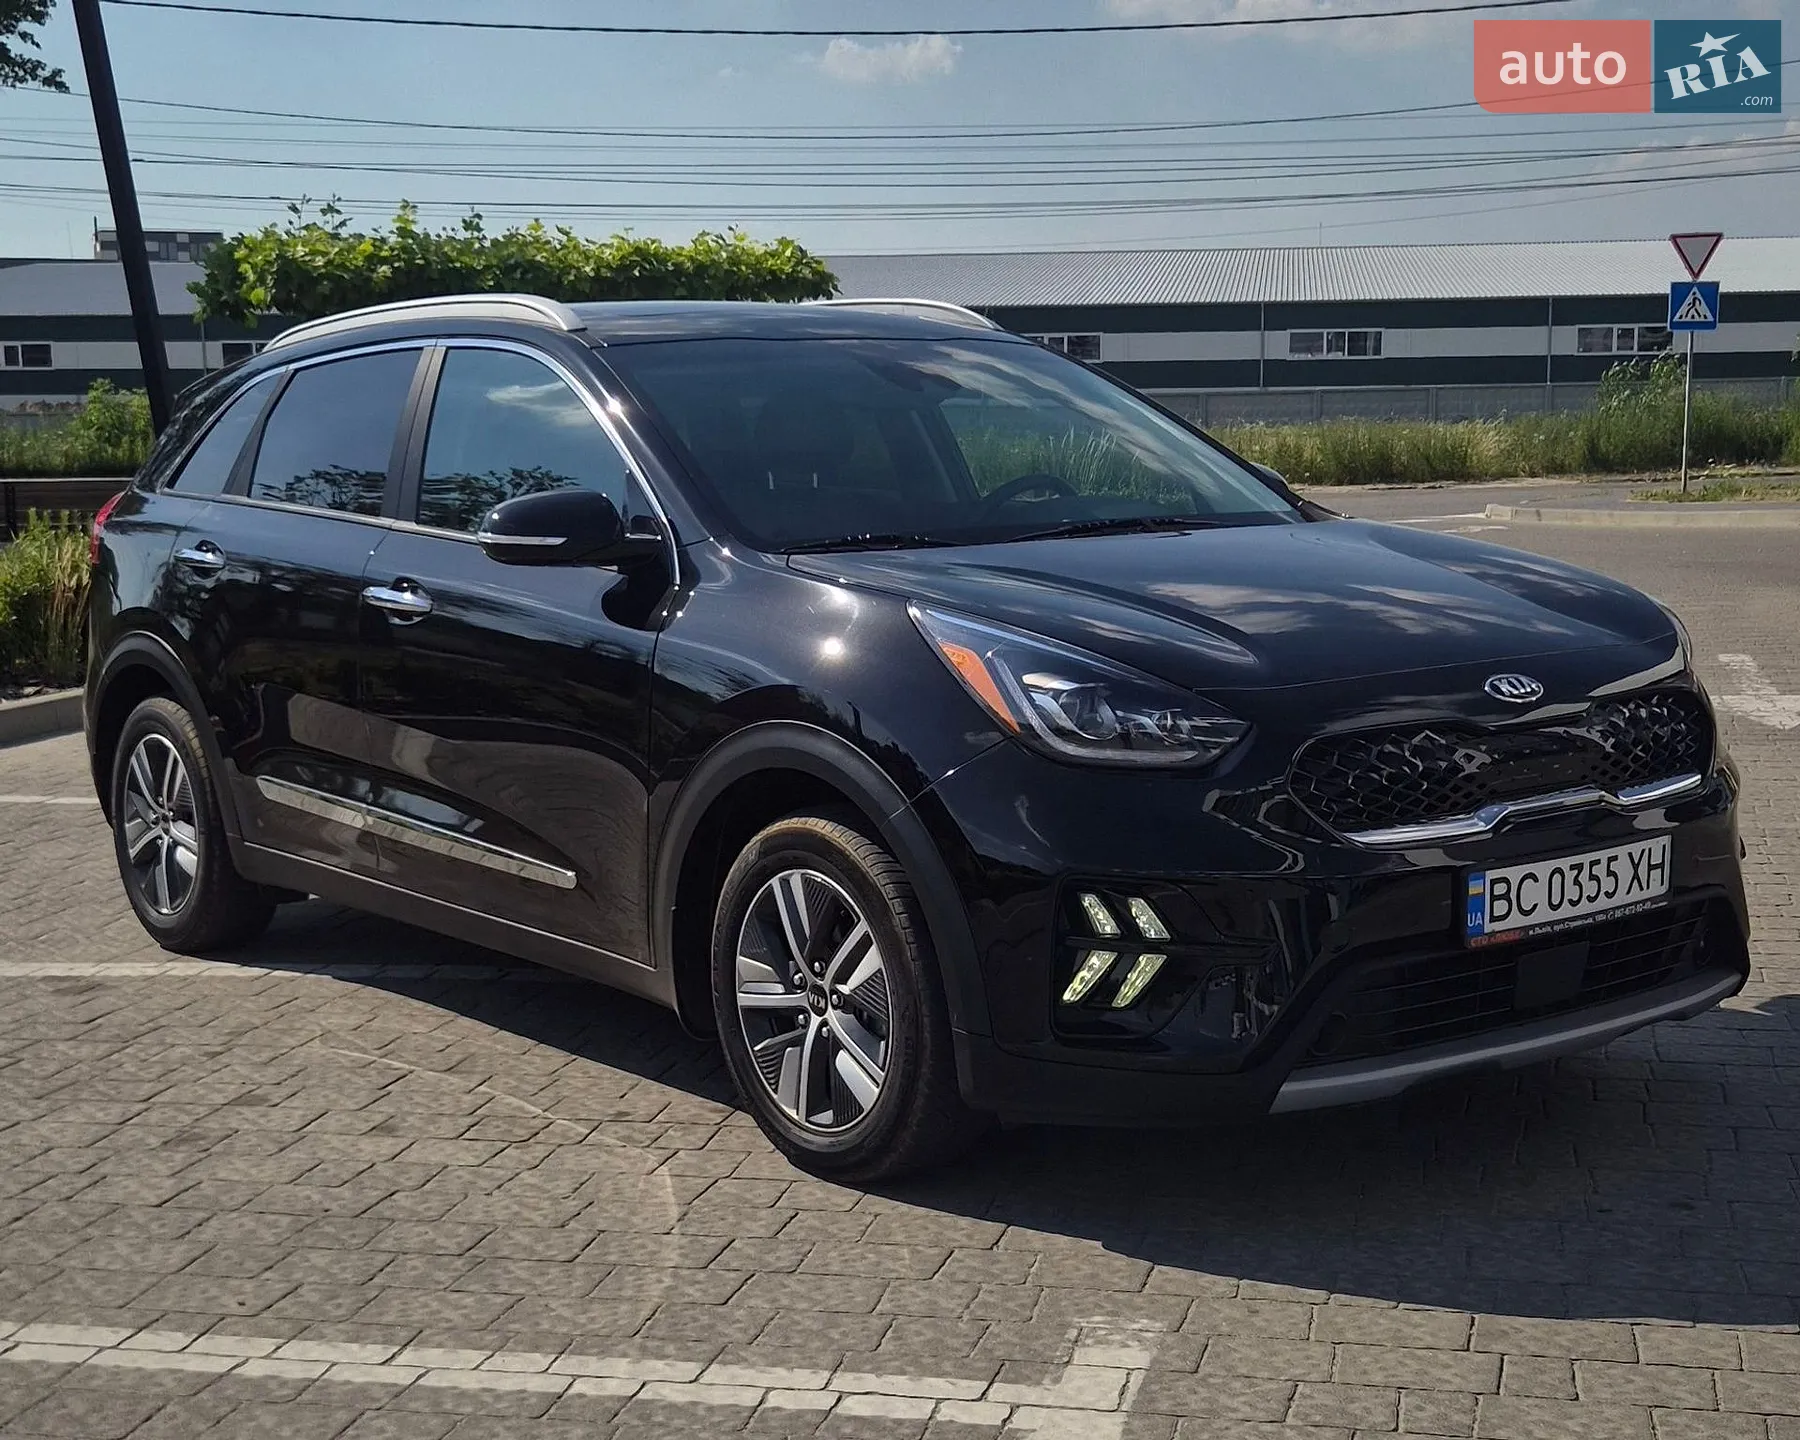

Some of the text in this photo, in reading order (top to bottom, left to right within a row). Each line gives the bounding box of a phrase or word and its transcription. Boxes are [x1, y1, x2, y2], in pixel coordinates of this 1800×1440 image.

[1491, 677, 1540, 696] KIA
[1489, 843, 1667, 924] BC 0355 XH
[1467, 912, 1484, 927] UA
[808, 991, 826, 1009] KIA
